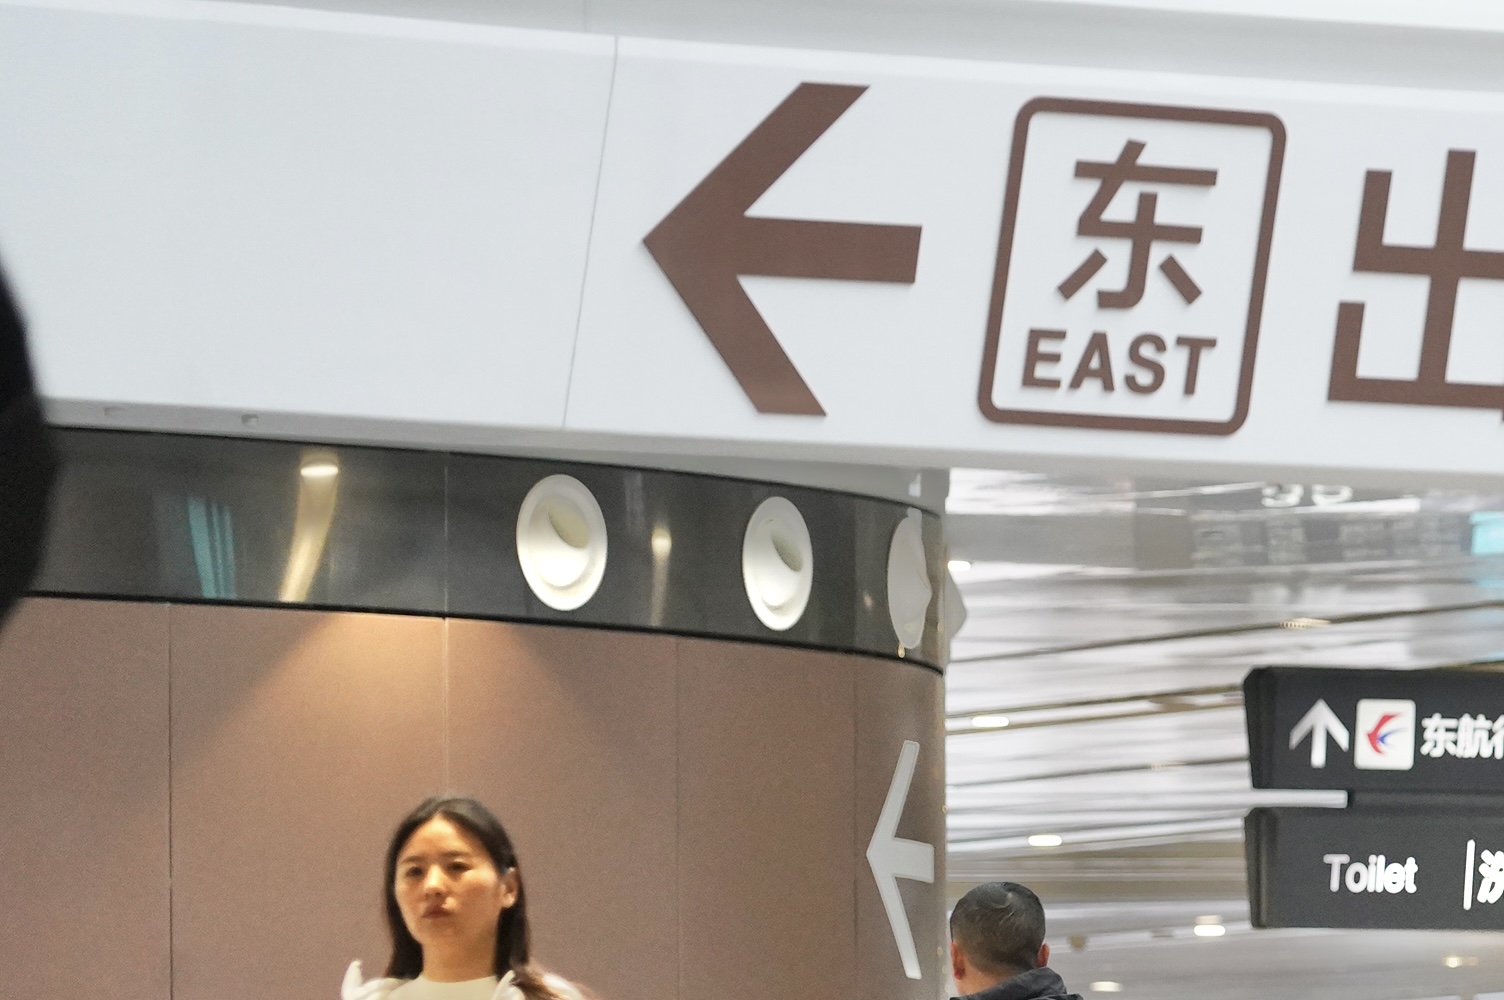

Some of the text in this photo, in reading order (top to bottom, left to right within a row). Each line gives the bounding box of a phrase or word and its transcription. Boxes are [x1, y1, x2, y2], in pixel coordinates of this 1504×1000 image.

[1057, 138, 1218, 310] 东
[1021, 328, 1218, 396] EAST
[1323, 853, 1419, 894] Toilet
